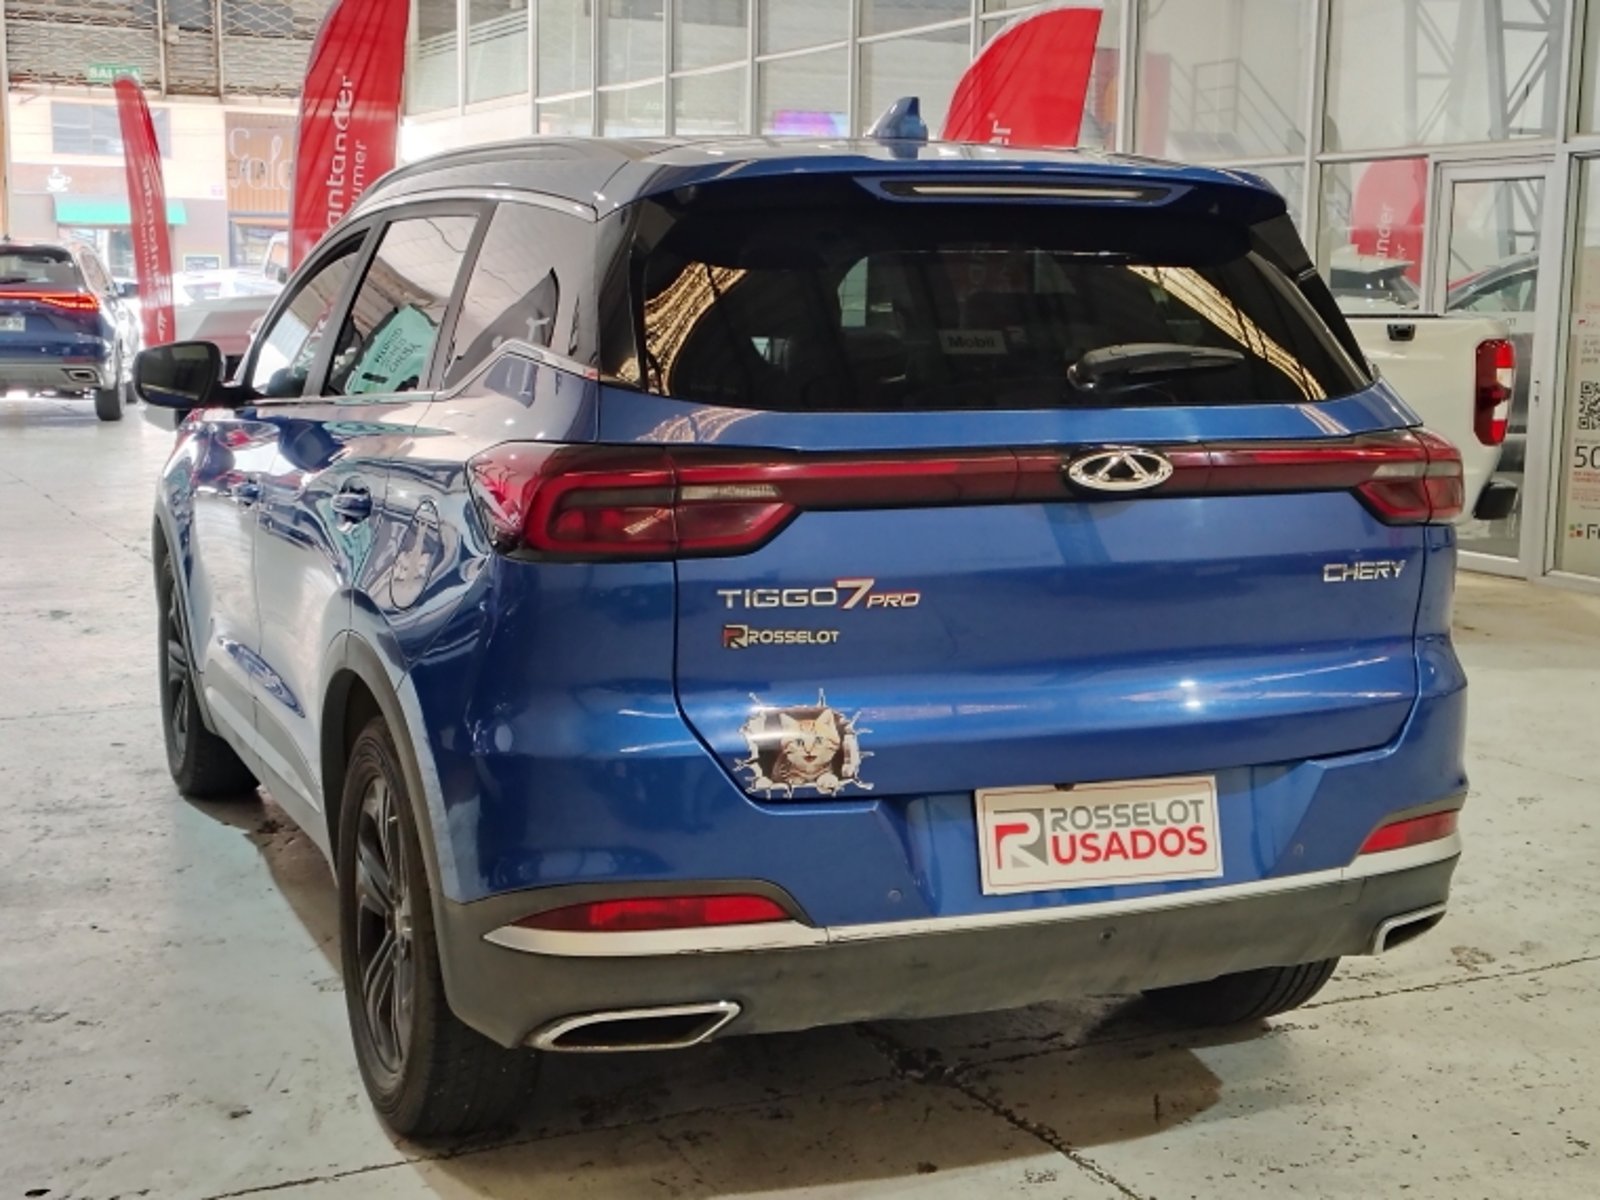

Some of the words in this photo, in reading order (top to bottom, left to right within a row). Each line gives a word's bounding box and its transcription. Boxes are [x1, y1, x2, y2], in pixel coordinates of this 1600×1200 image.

[325, 75, 354, 229] antander
[1323, 560, 1406, 582] CHERY
[716, 587, 838, 609] TIGGO
[866, 592, 922, 609] PRO
[748, 630, 840, 644] ROSSELOT
[1050, 799, 1204, 833] ROSSELOT
[1052, 825, 1208, 865] USADOS
